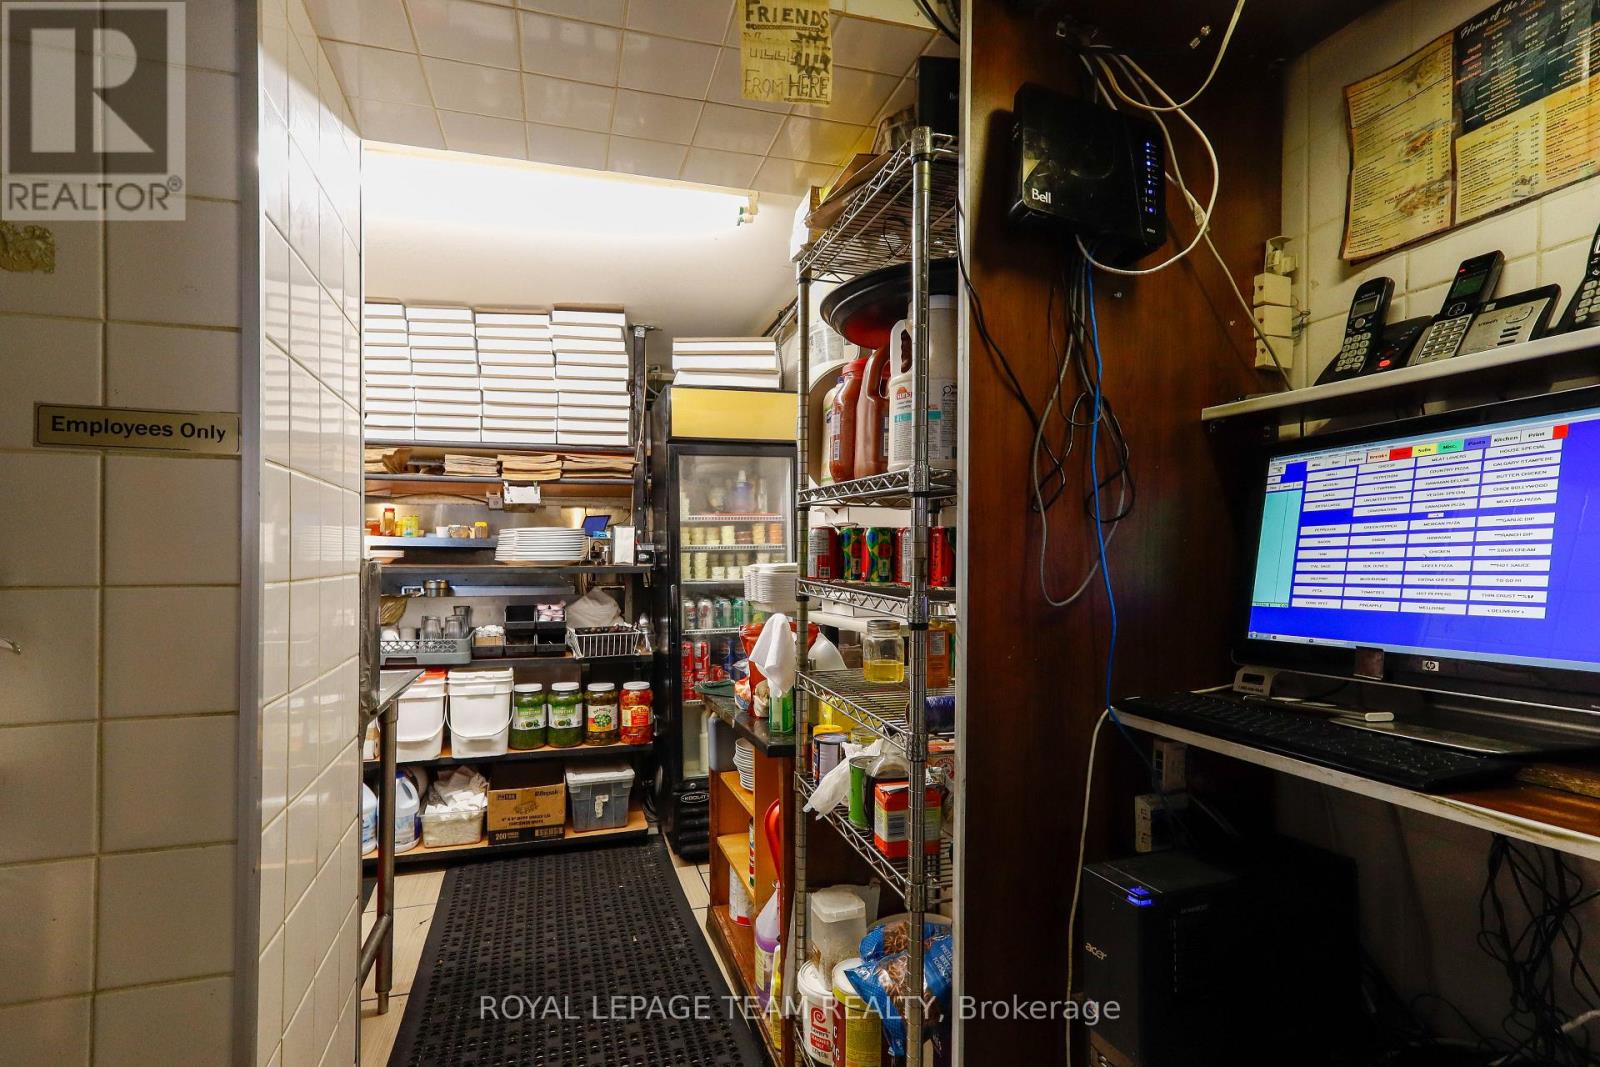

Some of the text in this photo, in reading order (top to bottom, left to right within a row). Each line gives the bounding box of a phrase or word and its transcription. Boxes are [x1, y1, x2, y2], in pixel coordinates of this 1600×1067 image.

[745, 0, 829, 30] FRIENDS
[744, 69, 830, 99] FROM HERE
[1032, 188, 1052, 204] Bell
[52, 416, 226, 443] Employees Only
